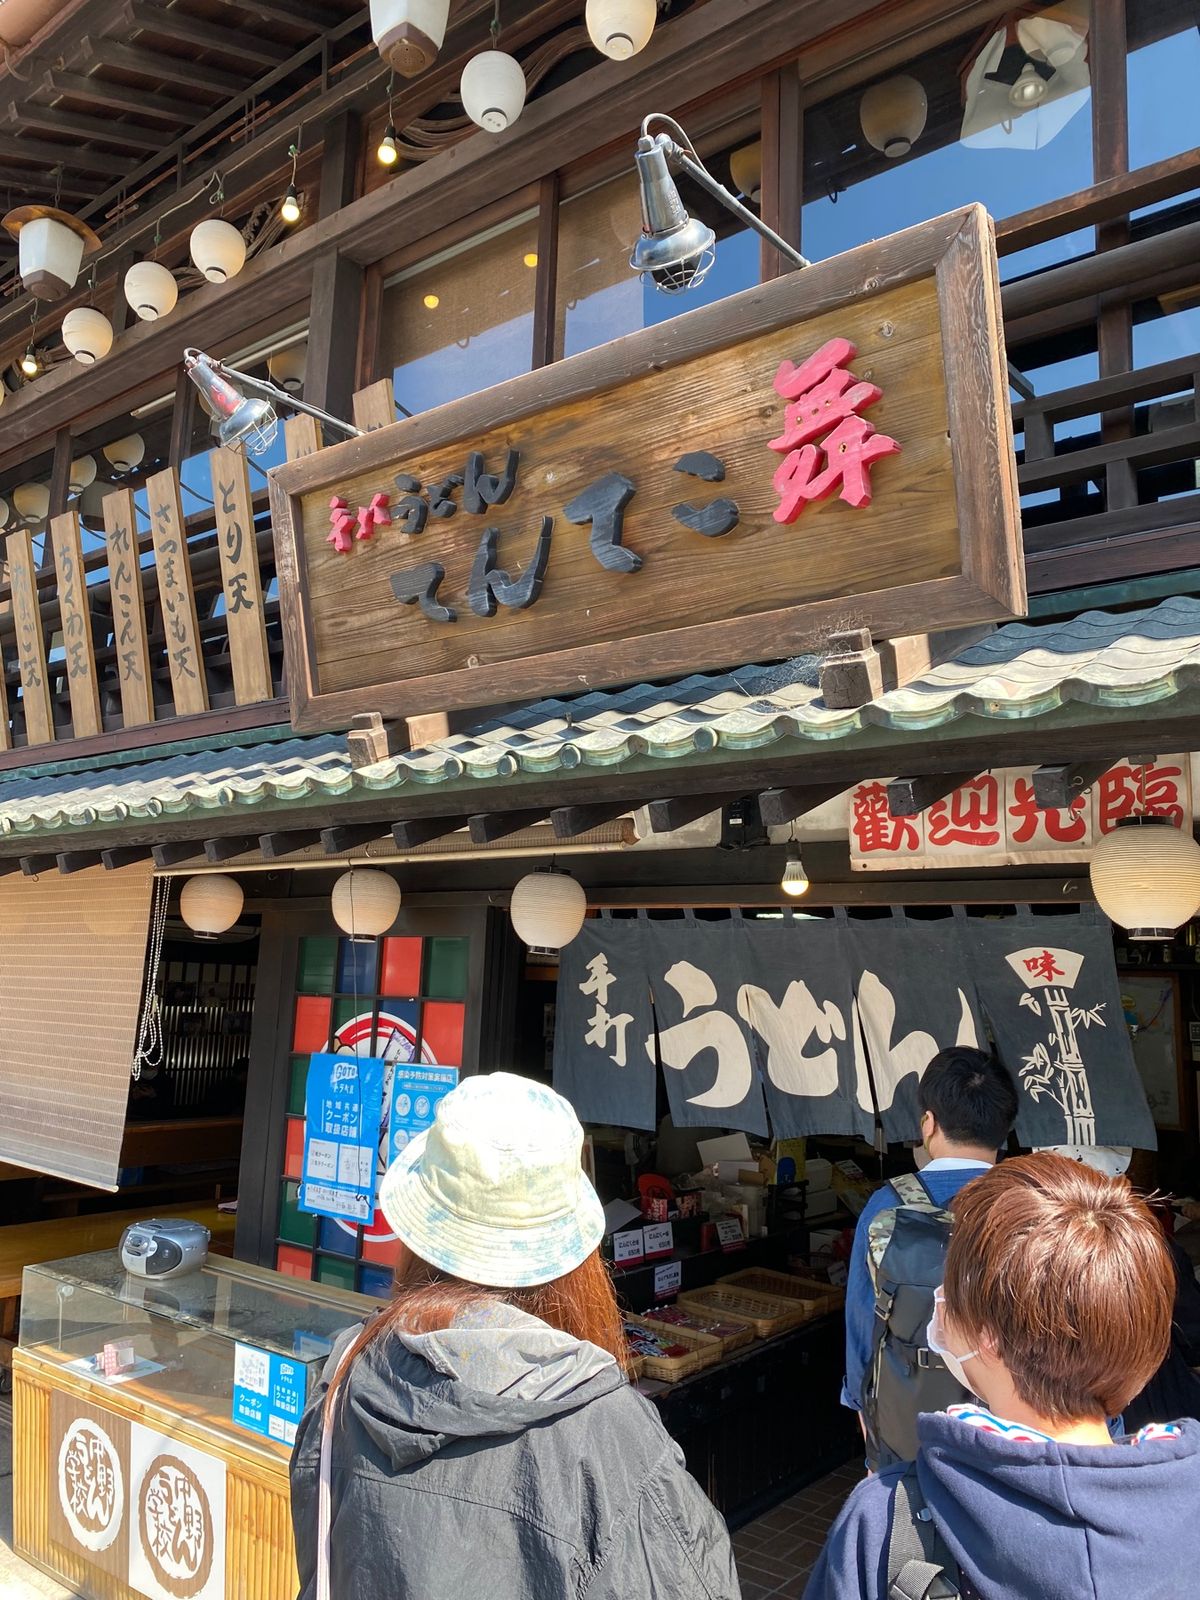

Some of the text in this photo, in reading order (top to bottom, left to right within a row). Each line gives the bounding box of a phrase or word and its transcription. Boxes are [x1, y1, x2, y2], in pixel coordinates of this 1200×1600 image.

[218, 479, 254, 614] とり天
[390, 337, 900, 622] てんてこ舞
[59, 543, 88, 679] ちくわ天
[109, 521, 142, 681] れんこん天
[154, 503, 196, 680] さつまいも天
[579, 952, 634, 1068] 手打
[1022, 950, 1066, 982] 味
[645, 960, 980, 1114] うどん
[326, 1109, 358, 1124] クーポン
[240, 1393, 262, 1409] クーポン
